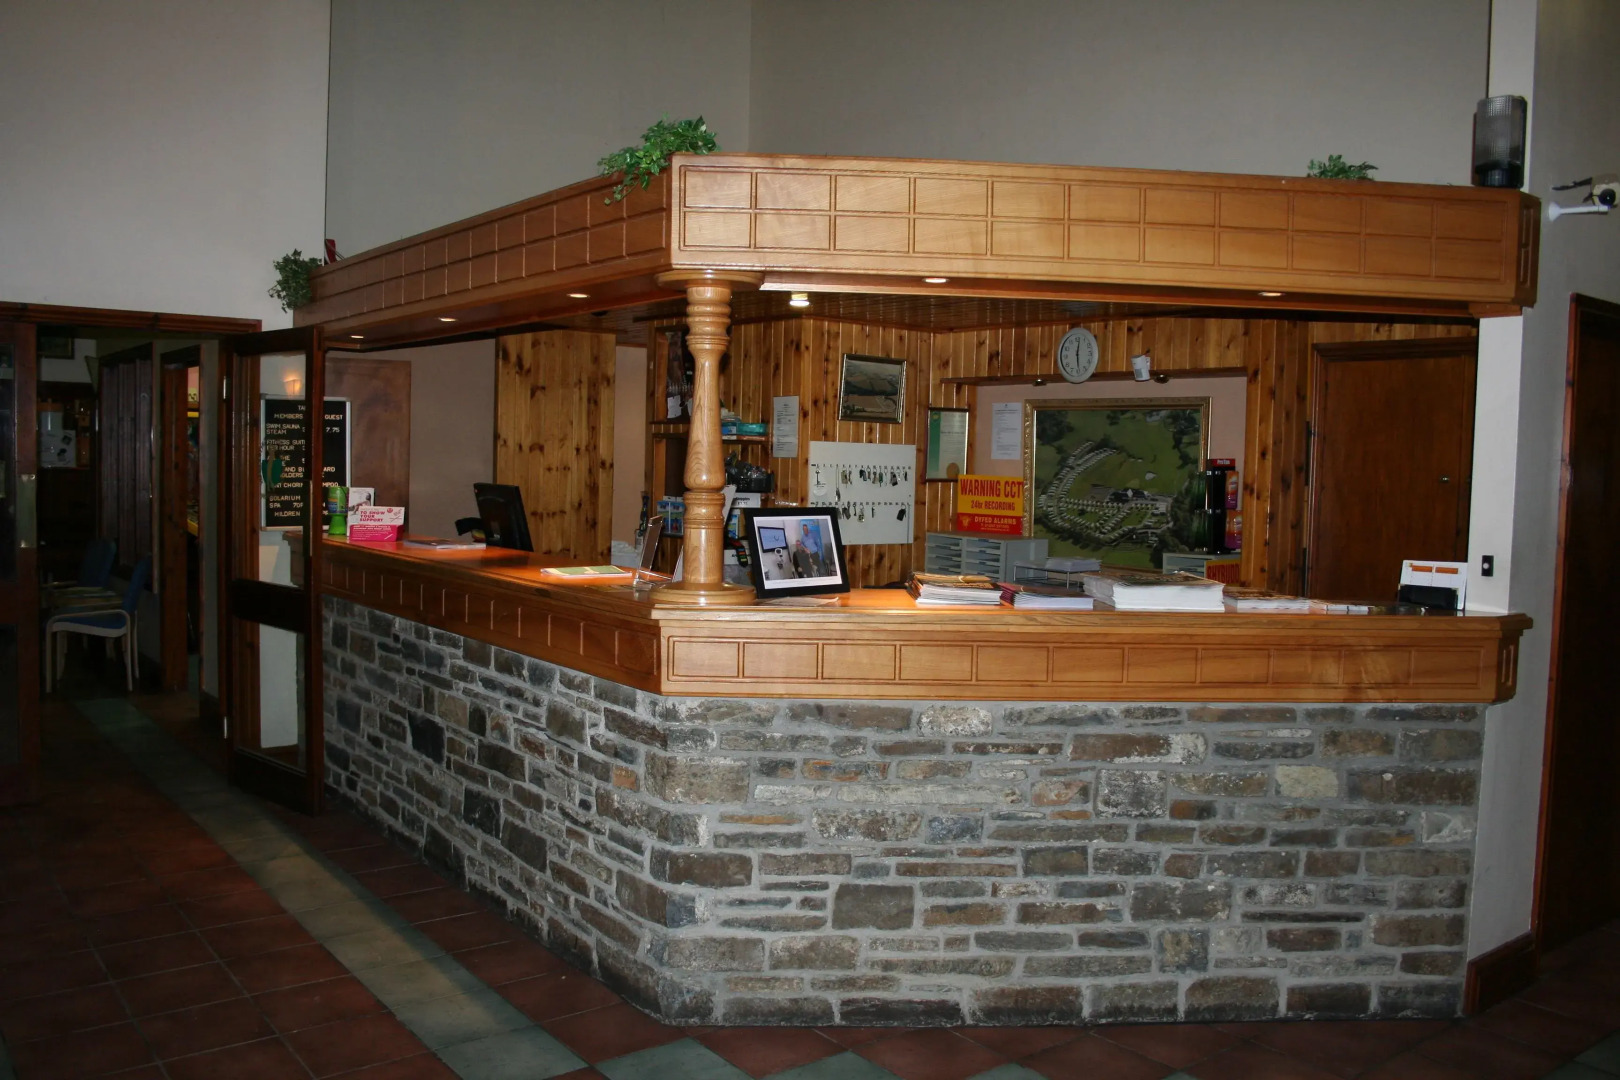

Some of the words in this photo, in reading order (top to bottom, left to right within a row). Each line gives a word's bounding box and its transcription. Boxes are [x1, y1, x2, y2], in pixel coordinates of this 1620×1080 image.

[960, 479, 1001, 498] WARNING
[1003, 480, 1024, 499] CCT
[971, 500, 983, 509] 24hr
[984, 501, 1015, 511] RECORDING
[993, 517, 1017, 525] ALARMS
